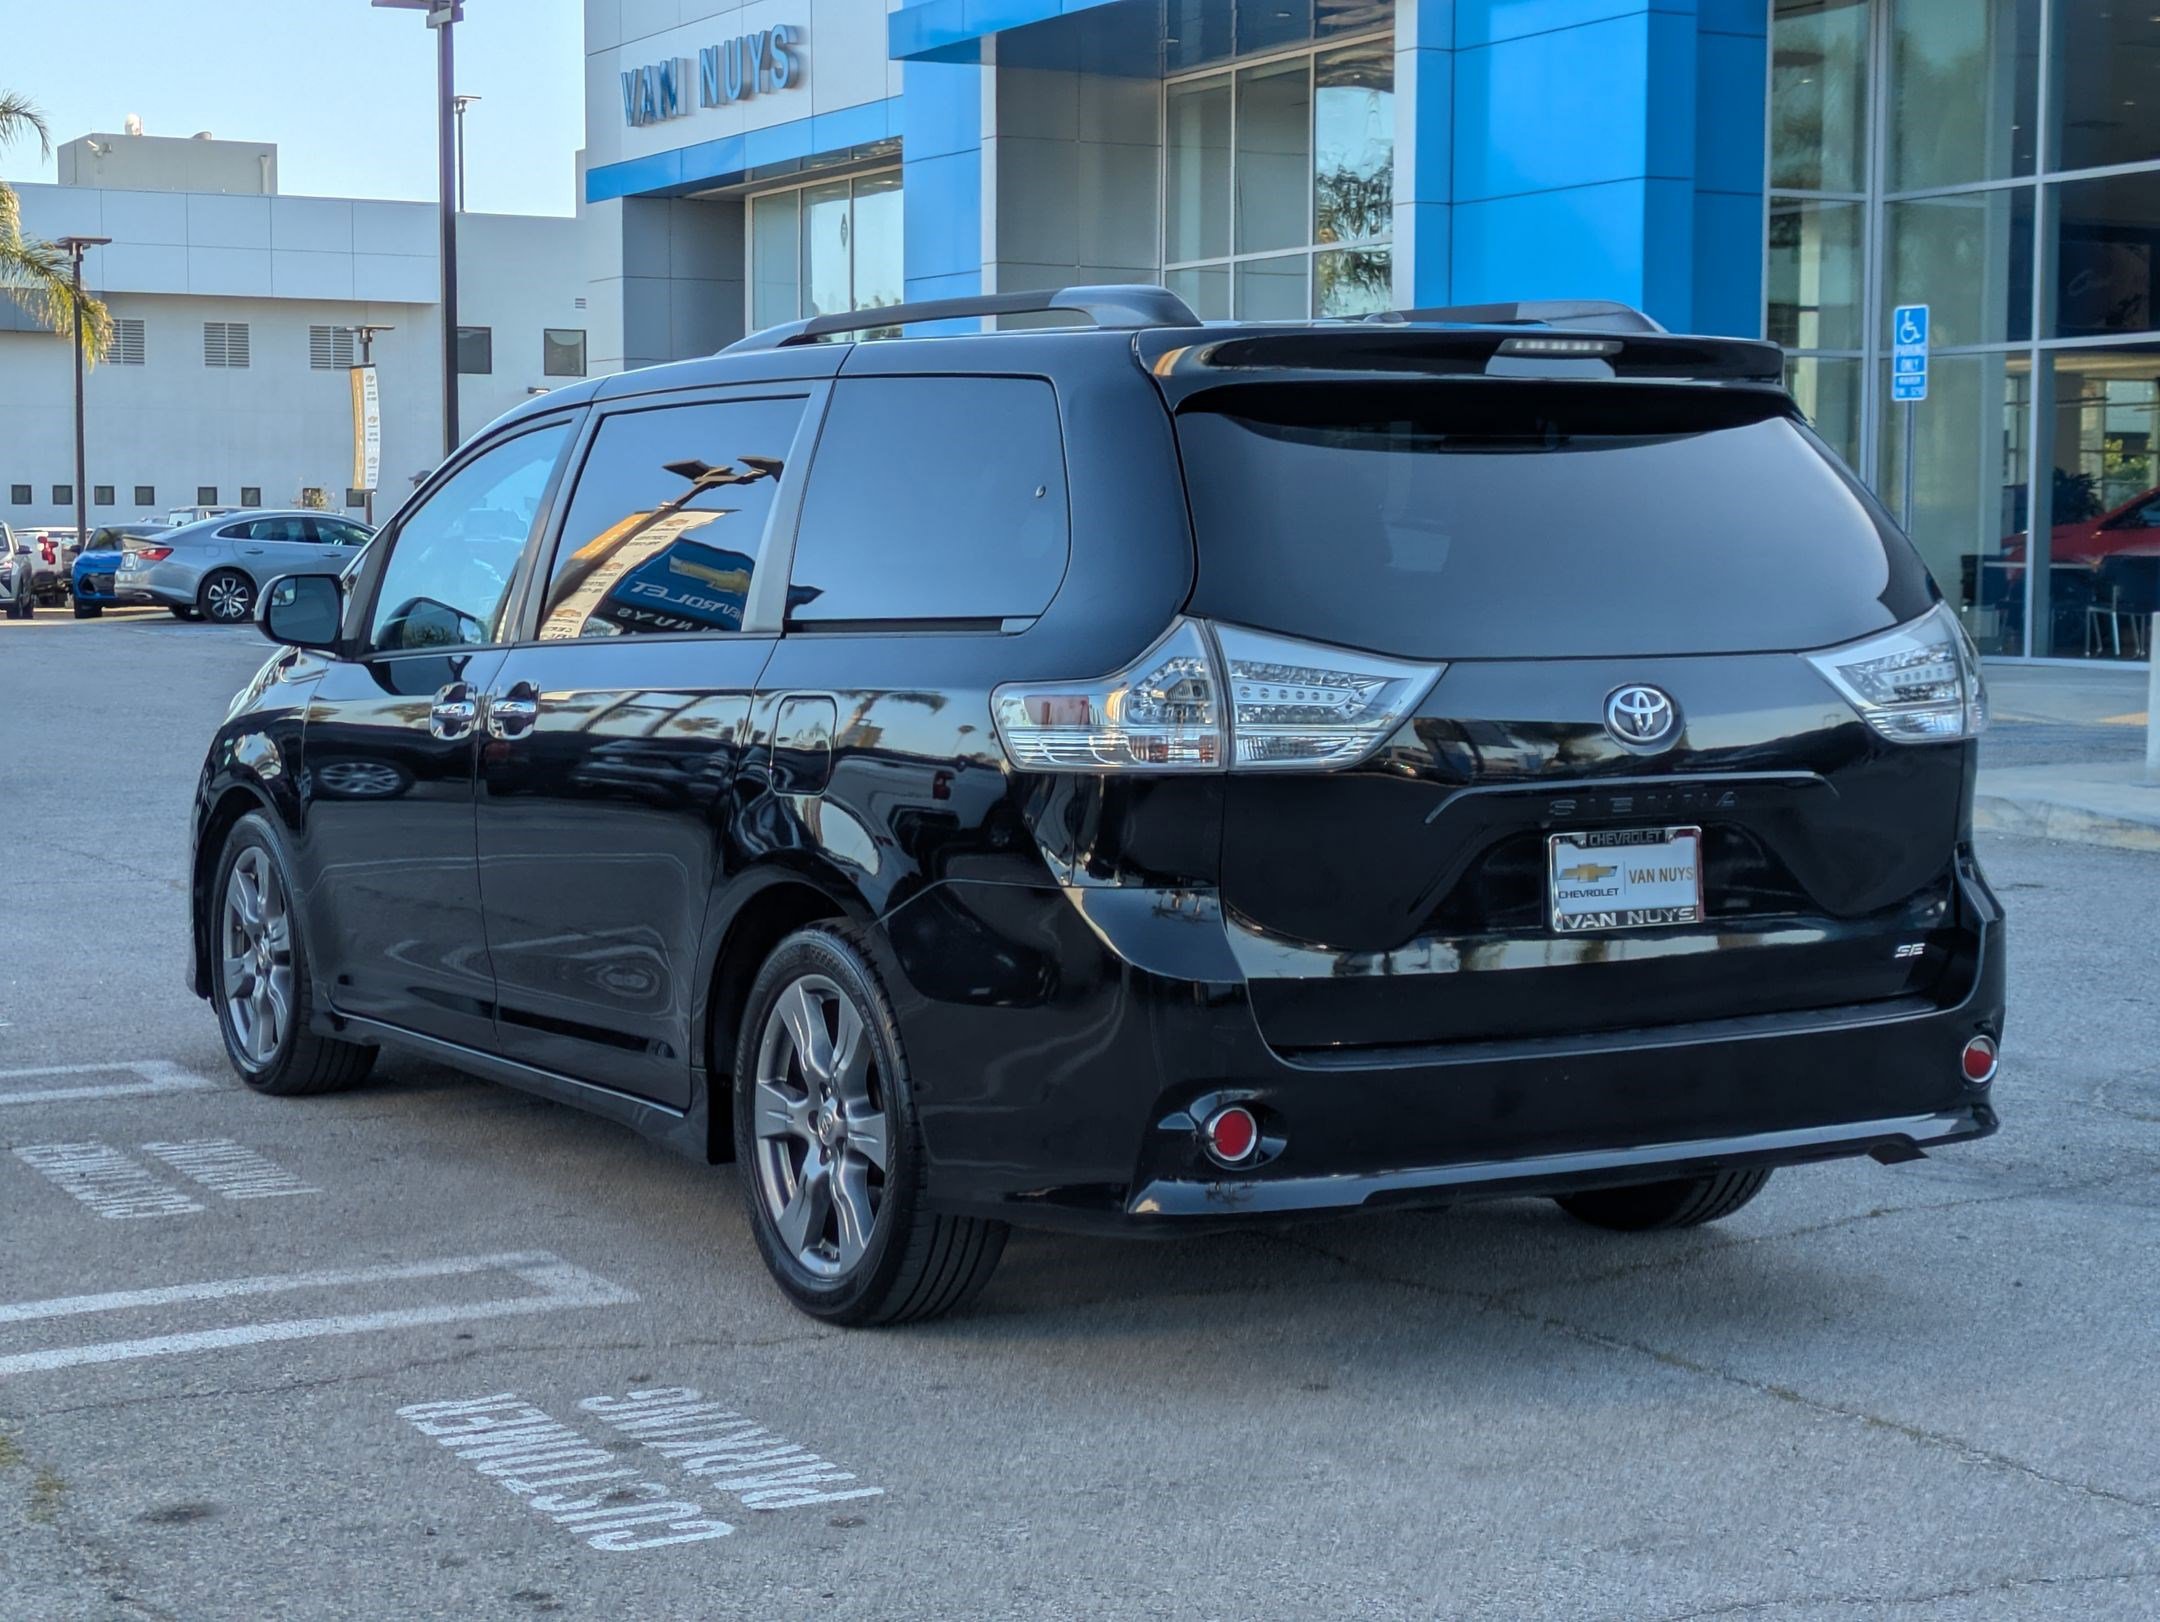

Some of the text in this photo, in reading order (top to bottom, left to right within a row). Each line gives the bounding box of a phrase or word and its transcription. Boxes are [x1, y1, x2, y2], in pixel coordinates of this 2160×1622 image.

[621, 24, 800, 127] VAN NUYS
[1589, 830, 1662, 847] CHEVROLET
[1629, 866, 1694, 884] VAN NUYS
[1558, 887, 1620, 900] CHEVROLET
[1564, 906, 1696, 930] VAN NUYS
[1894, 942, 1925, 958] SE
[578, 1387, 885, 1510] PARKING
[394, 1392, 736, 1551] CUSTOMER
